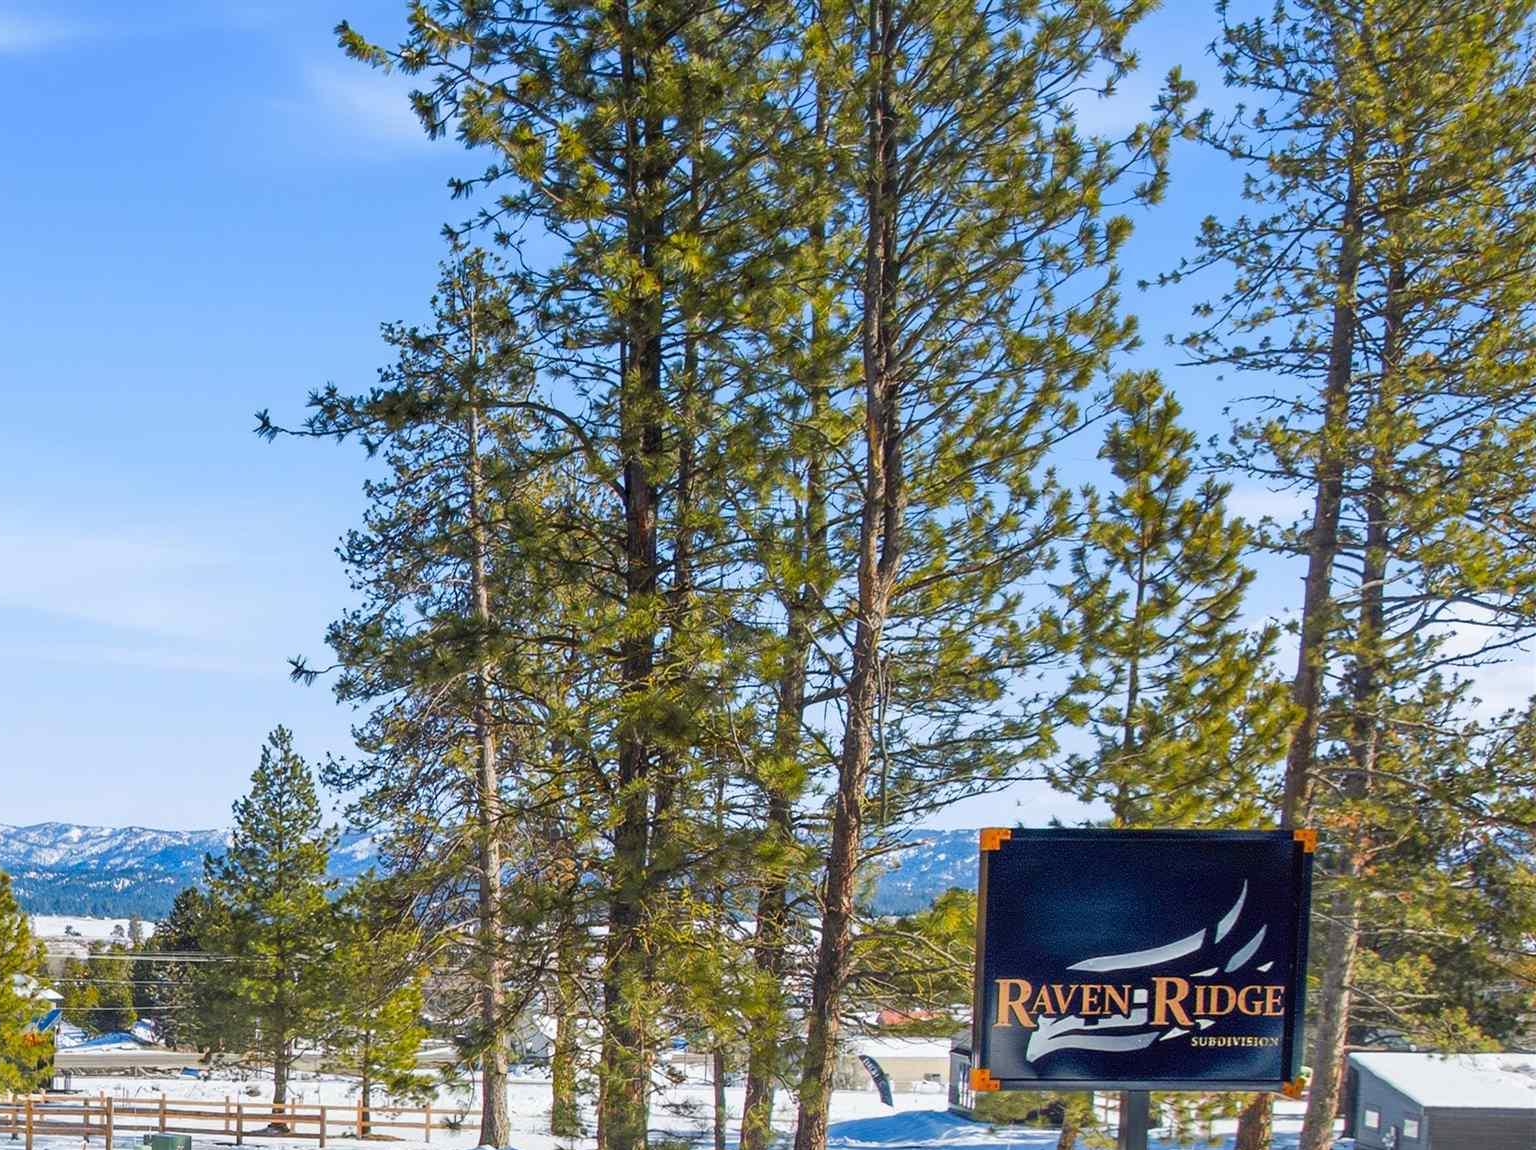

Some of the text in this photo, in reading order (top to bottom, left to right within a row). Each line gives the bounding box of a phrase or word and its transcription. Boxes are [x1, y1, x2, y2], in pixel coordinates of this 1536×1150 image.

[992, 976, 1285, 1028] RAVEN RIDGE
[1191, 1036, 1280, 1047] SUBDIVISION
